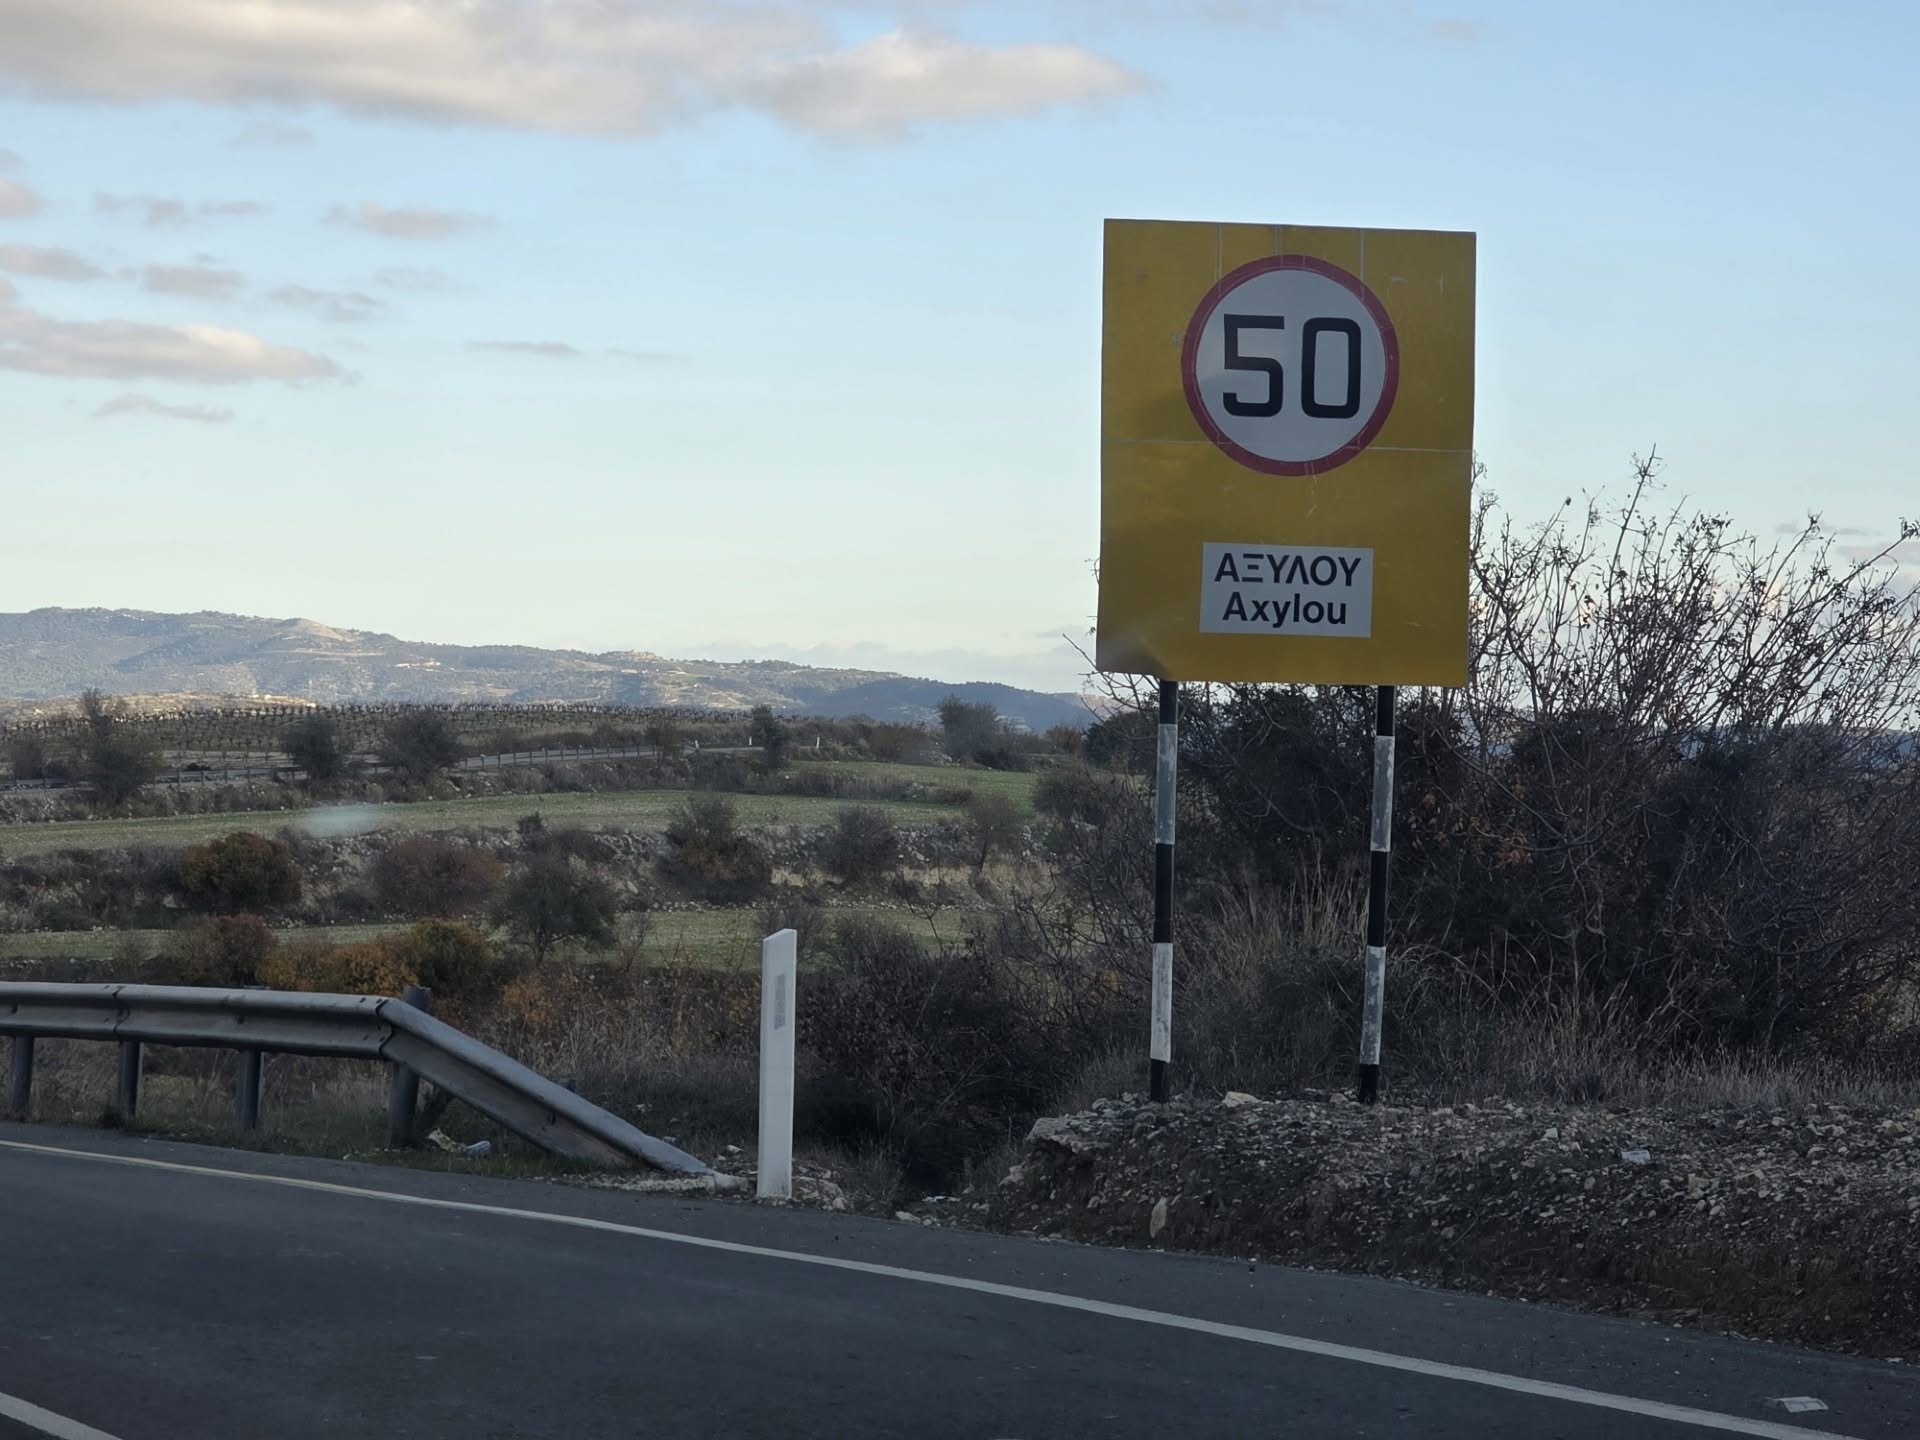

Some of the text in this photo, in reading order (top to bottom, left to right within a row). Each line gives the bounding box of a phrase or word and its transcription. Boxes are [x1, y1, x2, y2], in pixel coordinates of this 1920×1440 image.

[1223, 313, 1362, 419] 50
[1214, 552, 1362, 587] ΑΞΥΛΟΥ
[1222, 591, 1347, 629] Axylou
